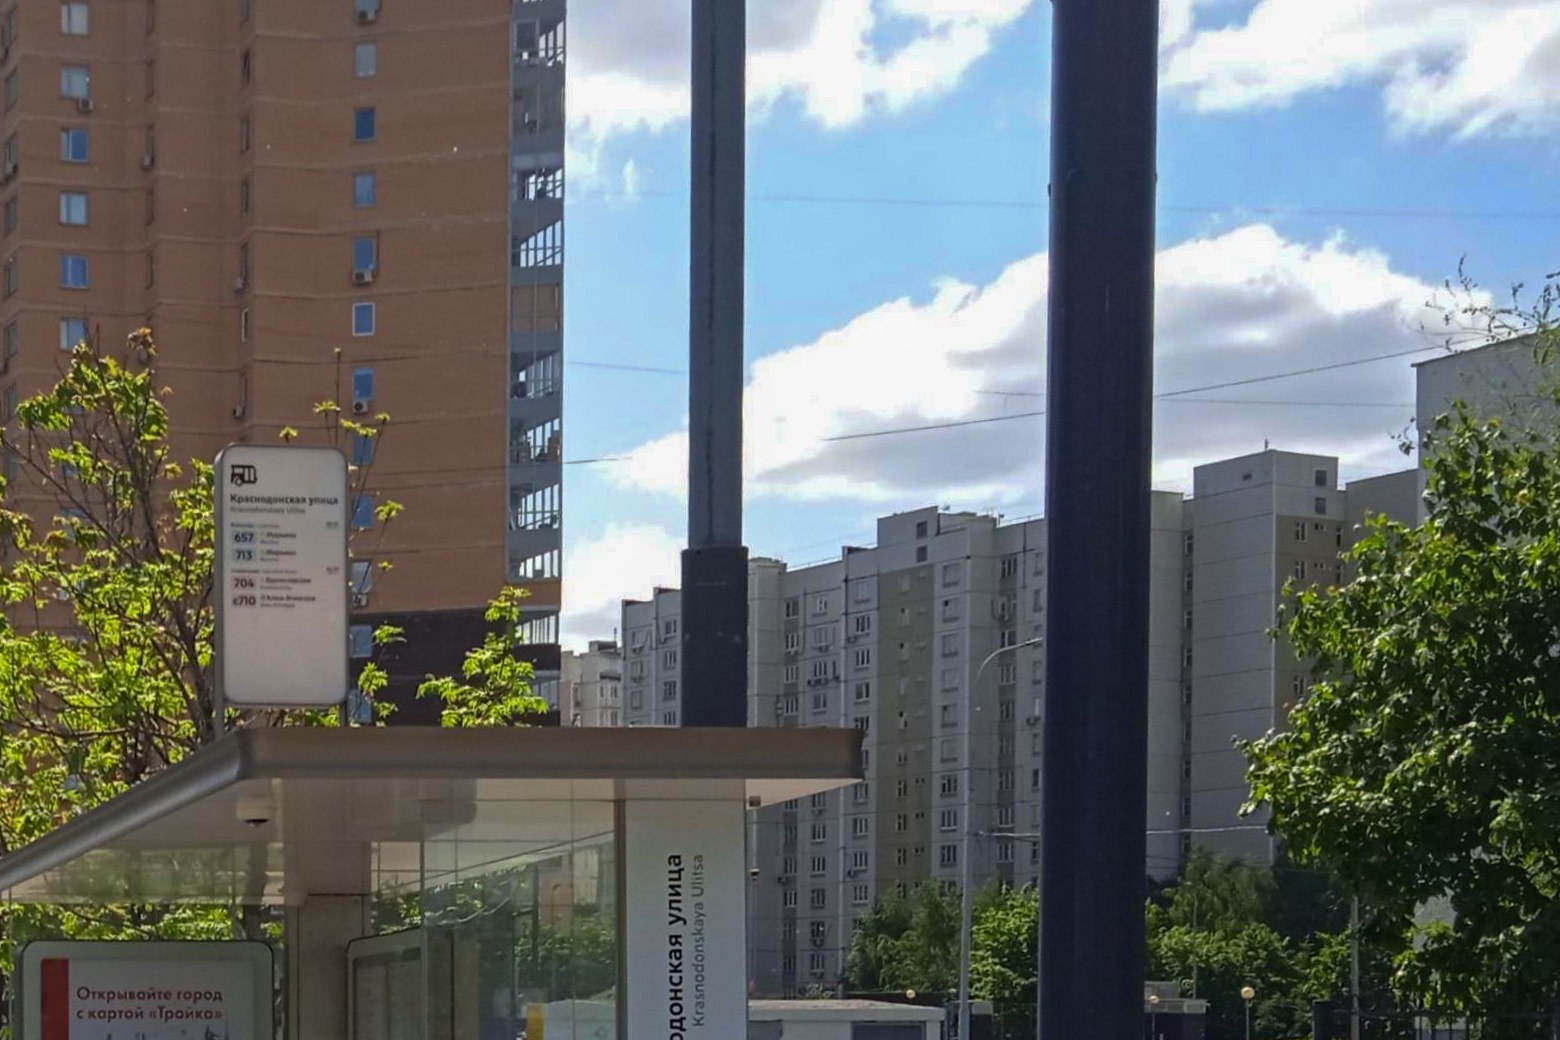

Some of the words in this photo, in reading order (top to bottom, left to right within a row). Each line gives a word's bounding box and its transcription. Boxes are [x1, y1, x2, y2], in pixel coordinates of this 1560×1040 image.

[230, 494, 306, 505] Краснодонская
[308, 496, 338, 506] улица
[234, 532, 254, 543] 657
[236, 550, 253, 560] 713
[234, 578, 255, 588] 704
[691, 854, 704, 898] Ulitsa
[668, 853, 688, 926] улица
[692, 902, 707, 1027] Krasnodonskaya
[76, 986, 172, 1004] Открывайте
[177, 990, 223, 1004] город
[76, 1009, 84, 1019] с
[88, 1007, 144, 1023] картой
[149, 1005, 223, 1023] «Тройка»
